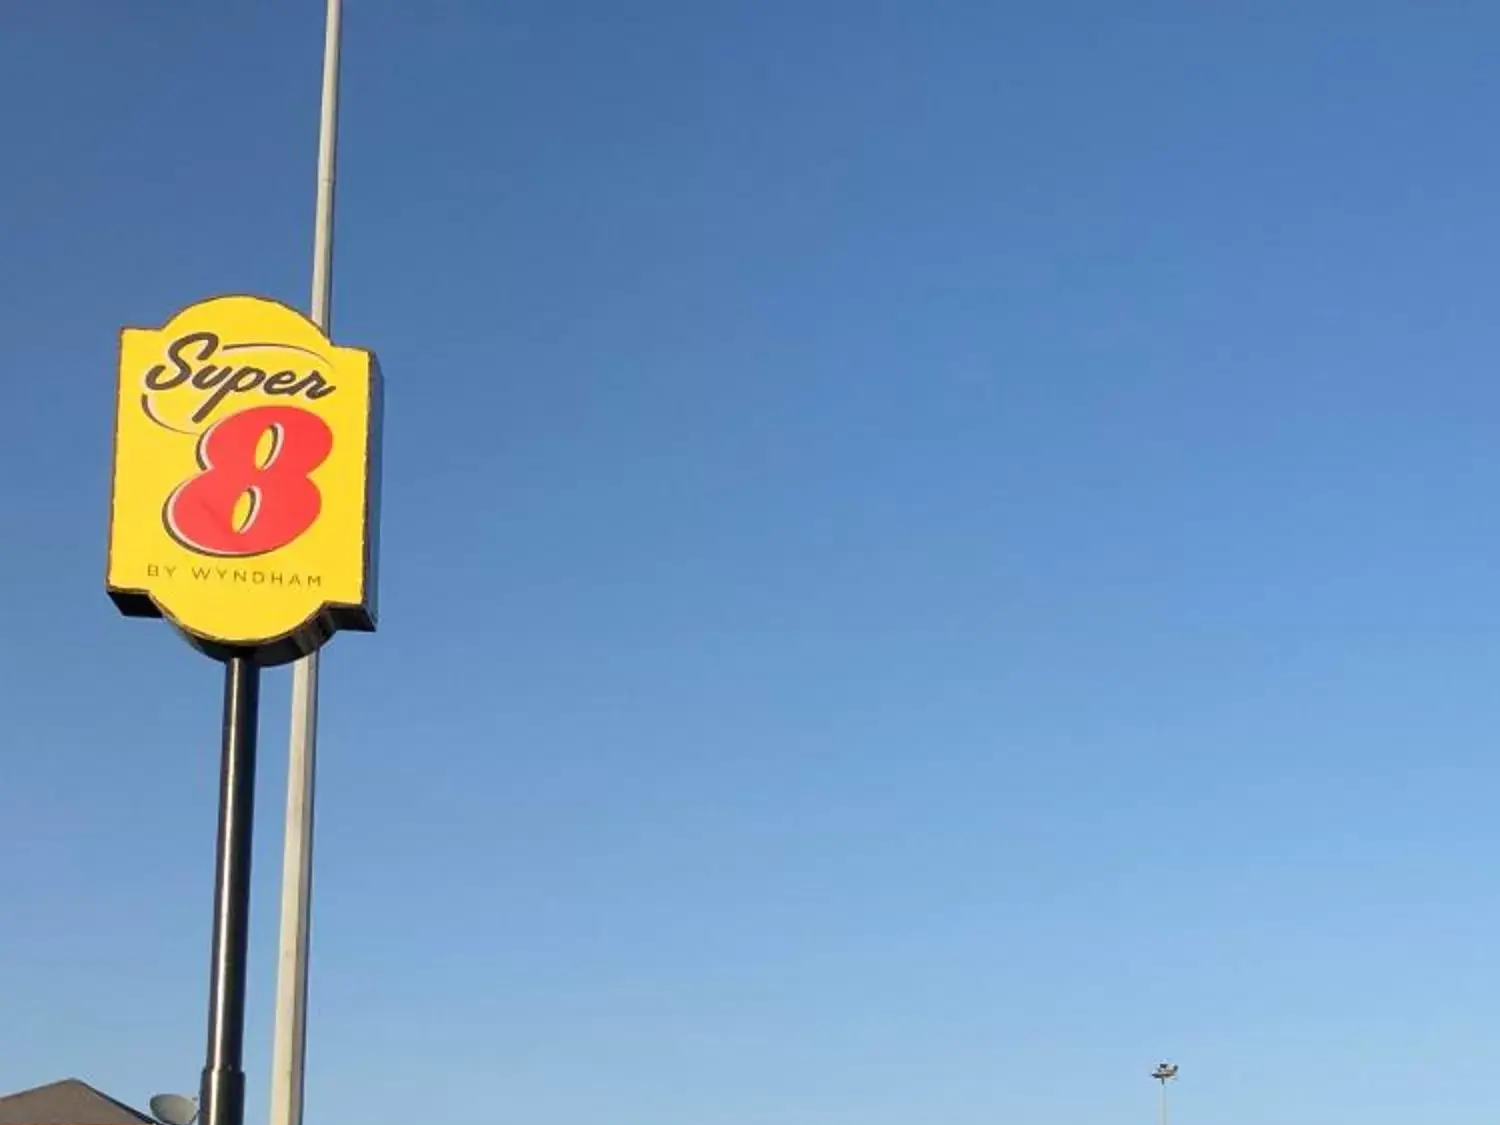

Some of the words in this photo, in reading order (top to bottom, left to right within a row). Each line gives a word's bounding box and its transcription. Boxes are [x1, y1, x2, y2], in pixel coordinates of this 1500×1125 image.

[145, 331, 337, 424] Super
[162, 405, 333, 557] 8
[147, 563, 177, 578] BY
[191, 566, 322, 588] WYNDHAM
